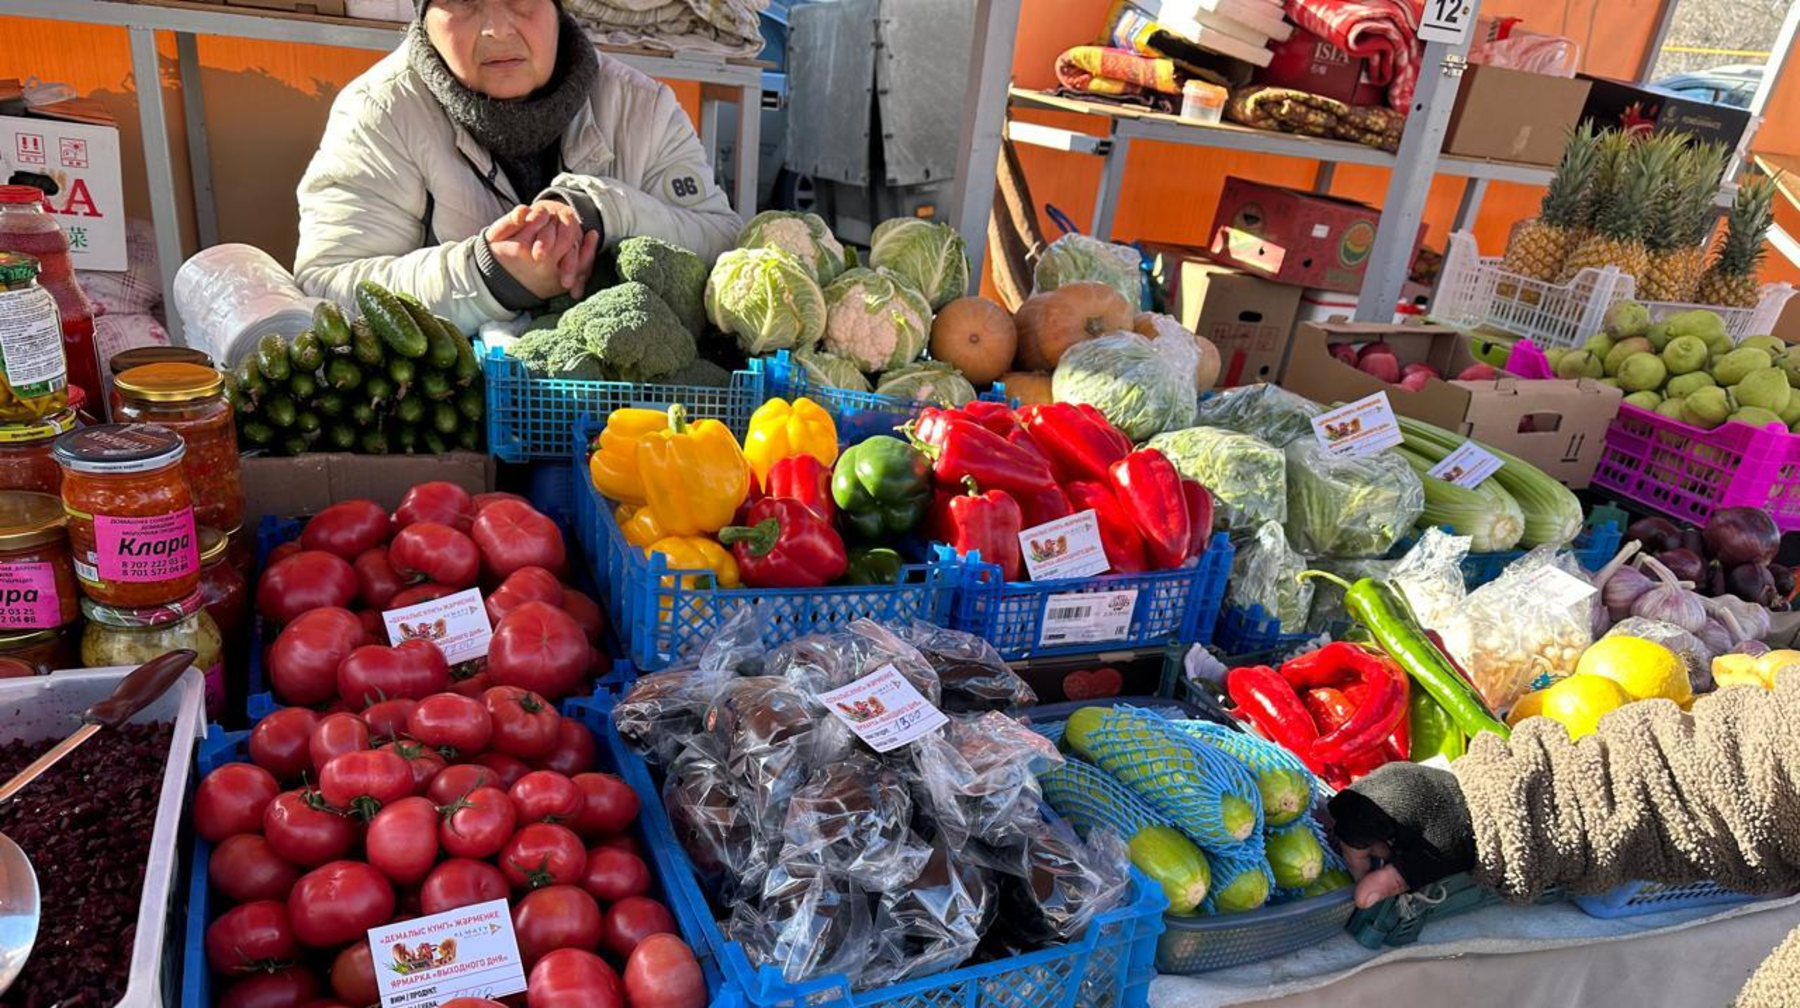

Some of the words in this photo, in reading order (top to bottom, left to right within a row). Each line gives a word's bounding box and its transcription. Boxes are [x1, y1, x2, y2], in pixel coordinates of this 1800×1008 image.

[1436, 0, 1462, 23] 12
[671, 176, 698, 197] 86
[118, 534, 190, 557] Клара
[121, 561, 128, 569] 8
[131, 561, 148, 569] 707
[151, 560, 166, 569] 222
[131, 569, 148, 577] 701
[151, 568, 167, 576] 572
[390, 972, 431, 988] ЯРМАРКА
[432, 960, 486, 978] «ВЫХОДНОГО
